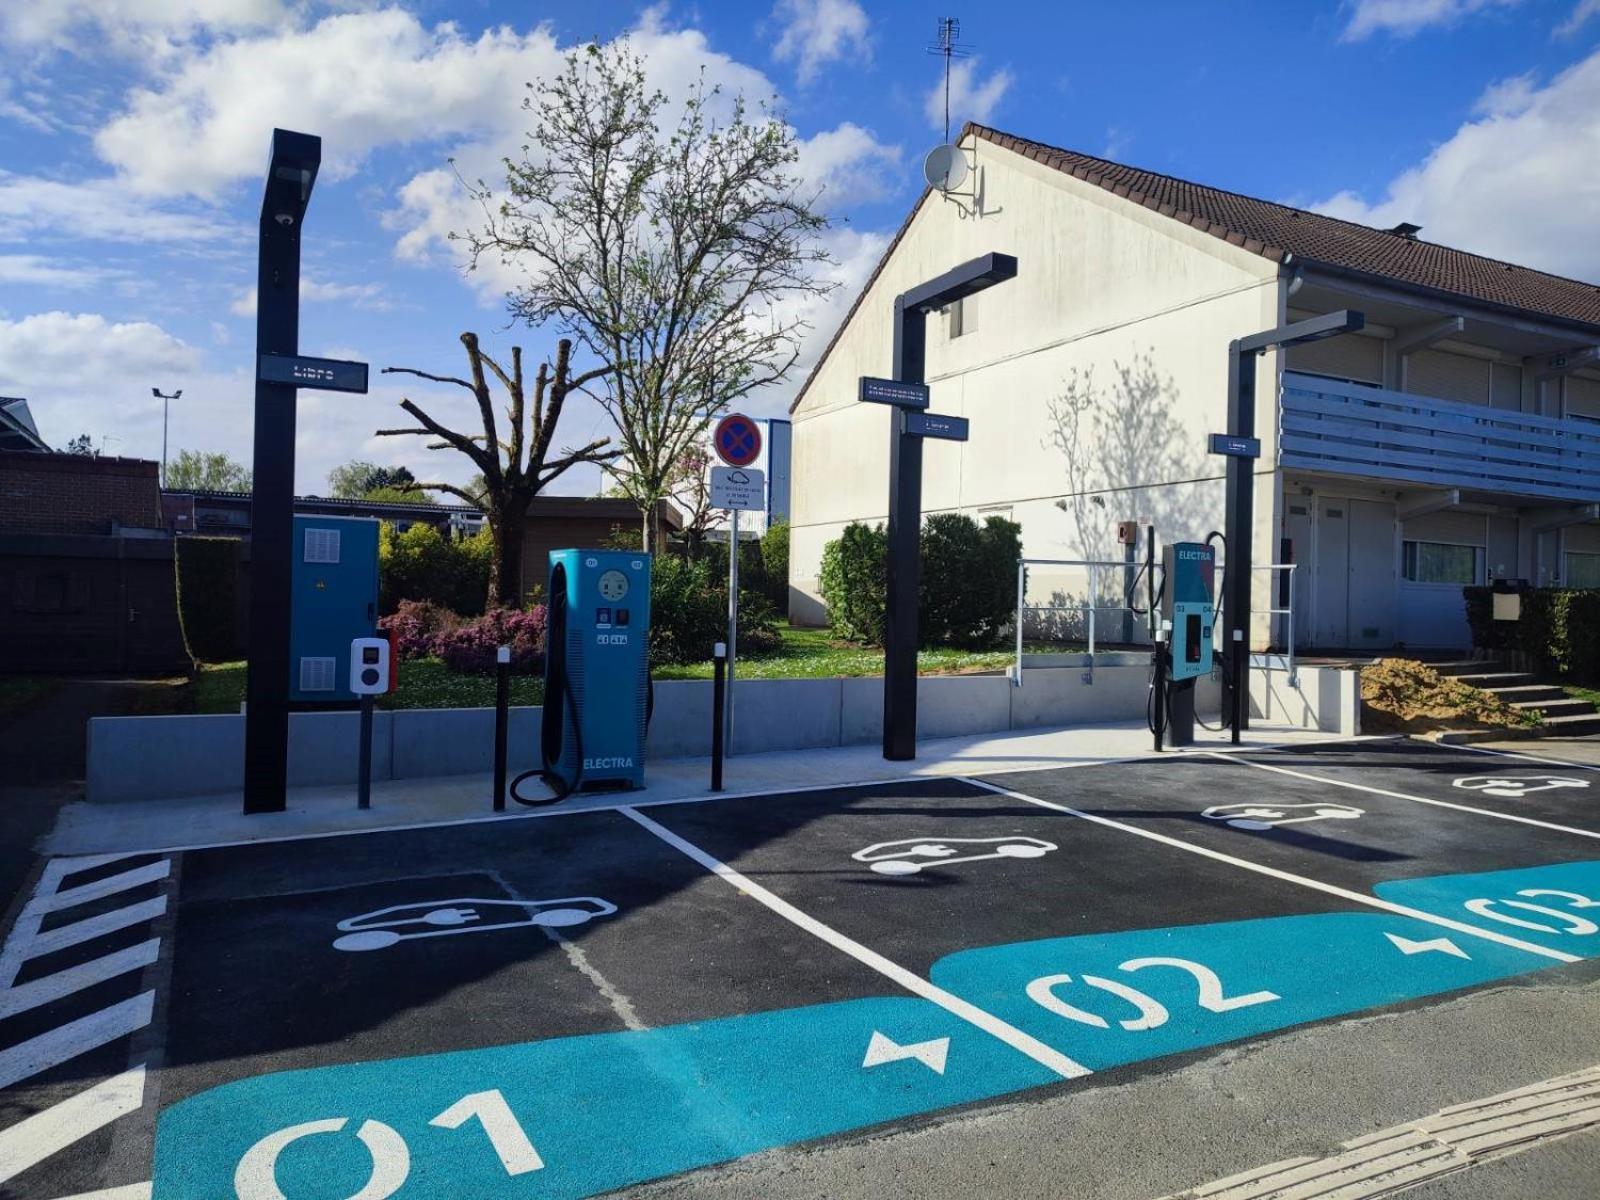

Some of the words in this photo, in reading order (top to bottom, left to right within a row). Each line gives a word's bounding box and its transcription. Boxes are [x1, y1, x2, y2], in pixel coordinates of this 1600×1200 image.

[1179, 550, 1211, 561] ELECTRA
[583, 757, 633, 770] ELECTRA
[1026, 957, 1280, 1031] 02
[234, 1089, 545, 1200] 01
